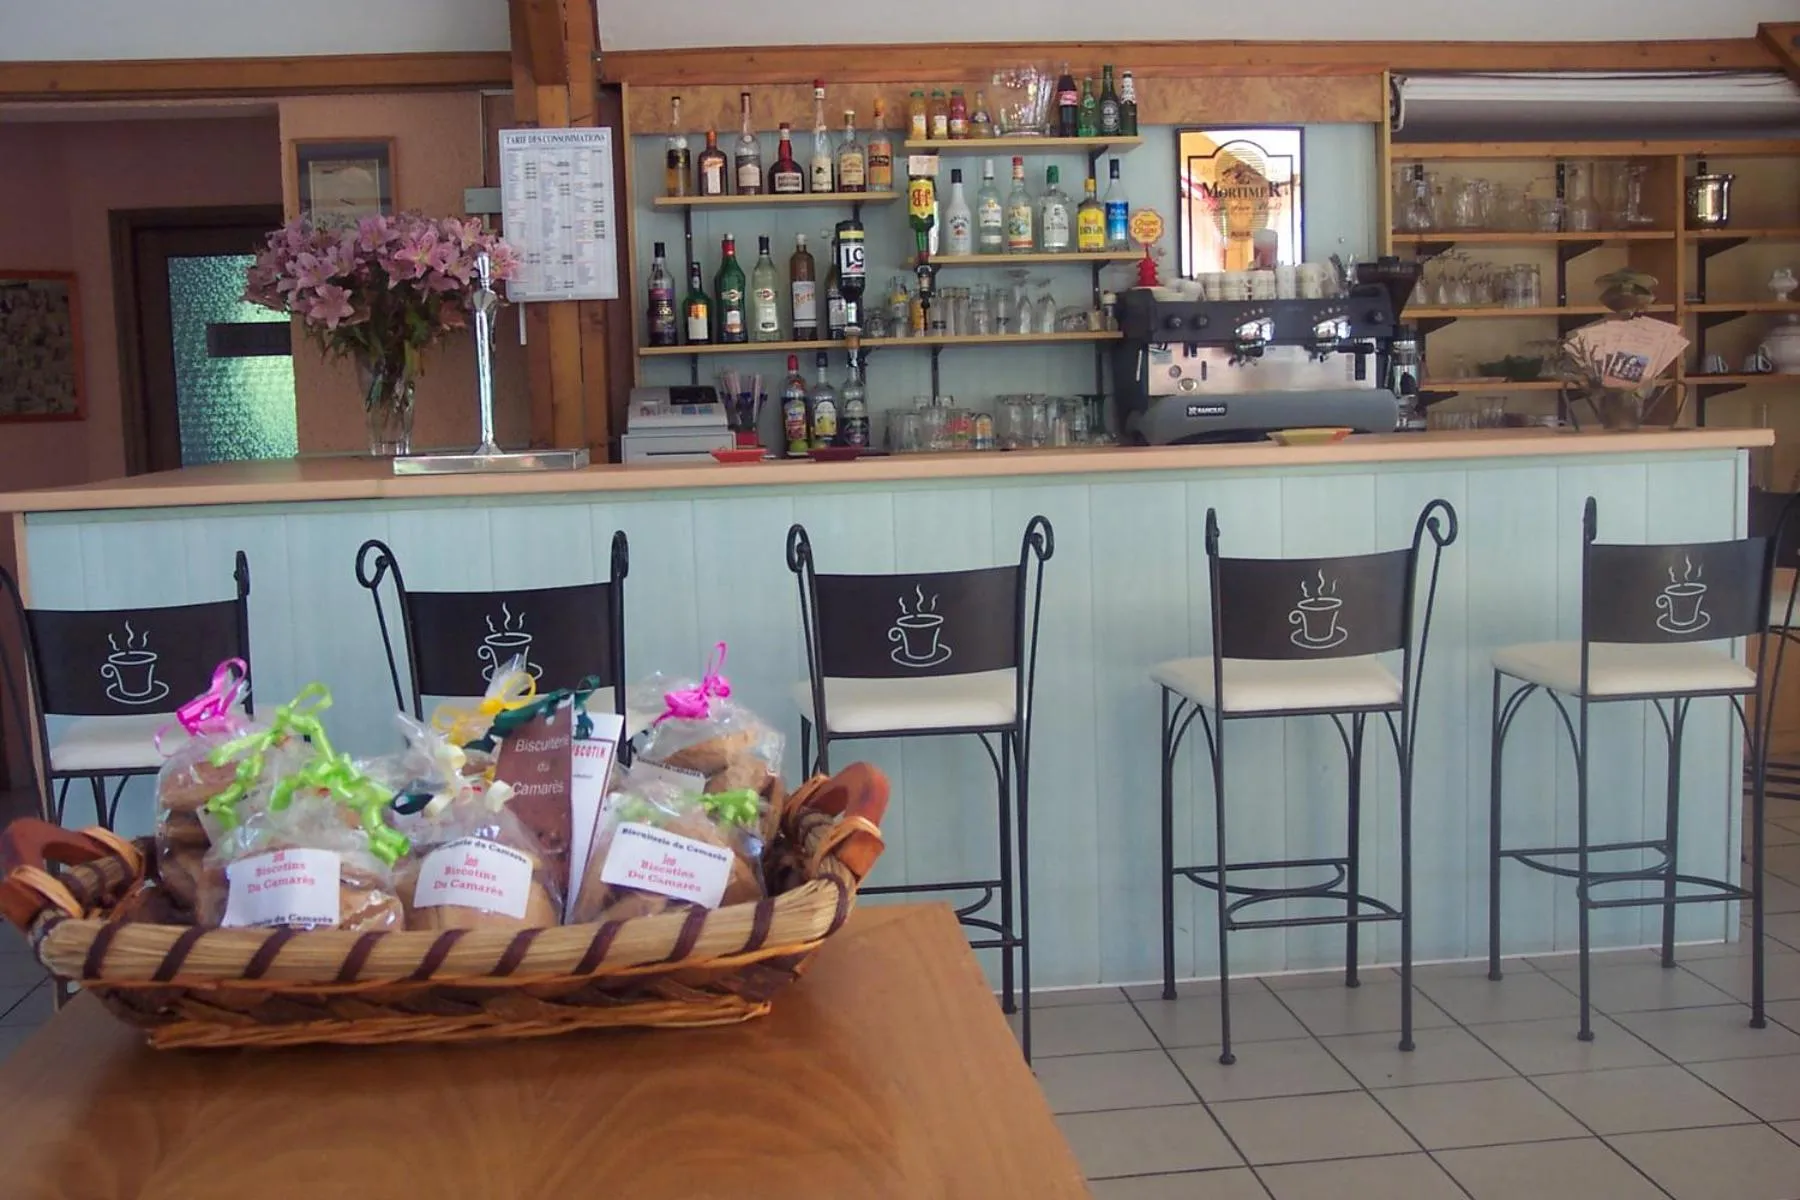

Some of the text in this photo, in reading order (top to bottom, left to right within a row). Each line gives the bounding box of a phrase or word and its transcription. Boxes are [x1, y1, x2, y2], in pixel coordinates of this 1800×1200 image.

[1202, 181, 1281, 199] MORTIMER
[845, 247, 864, 268] 51
[537, 763, 549, 772] du
